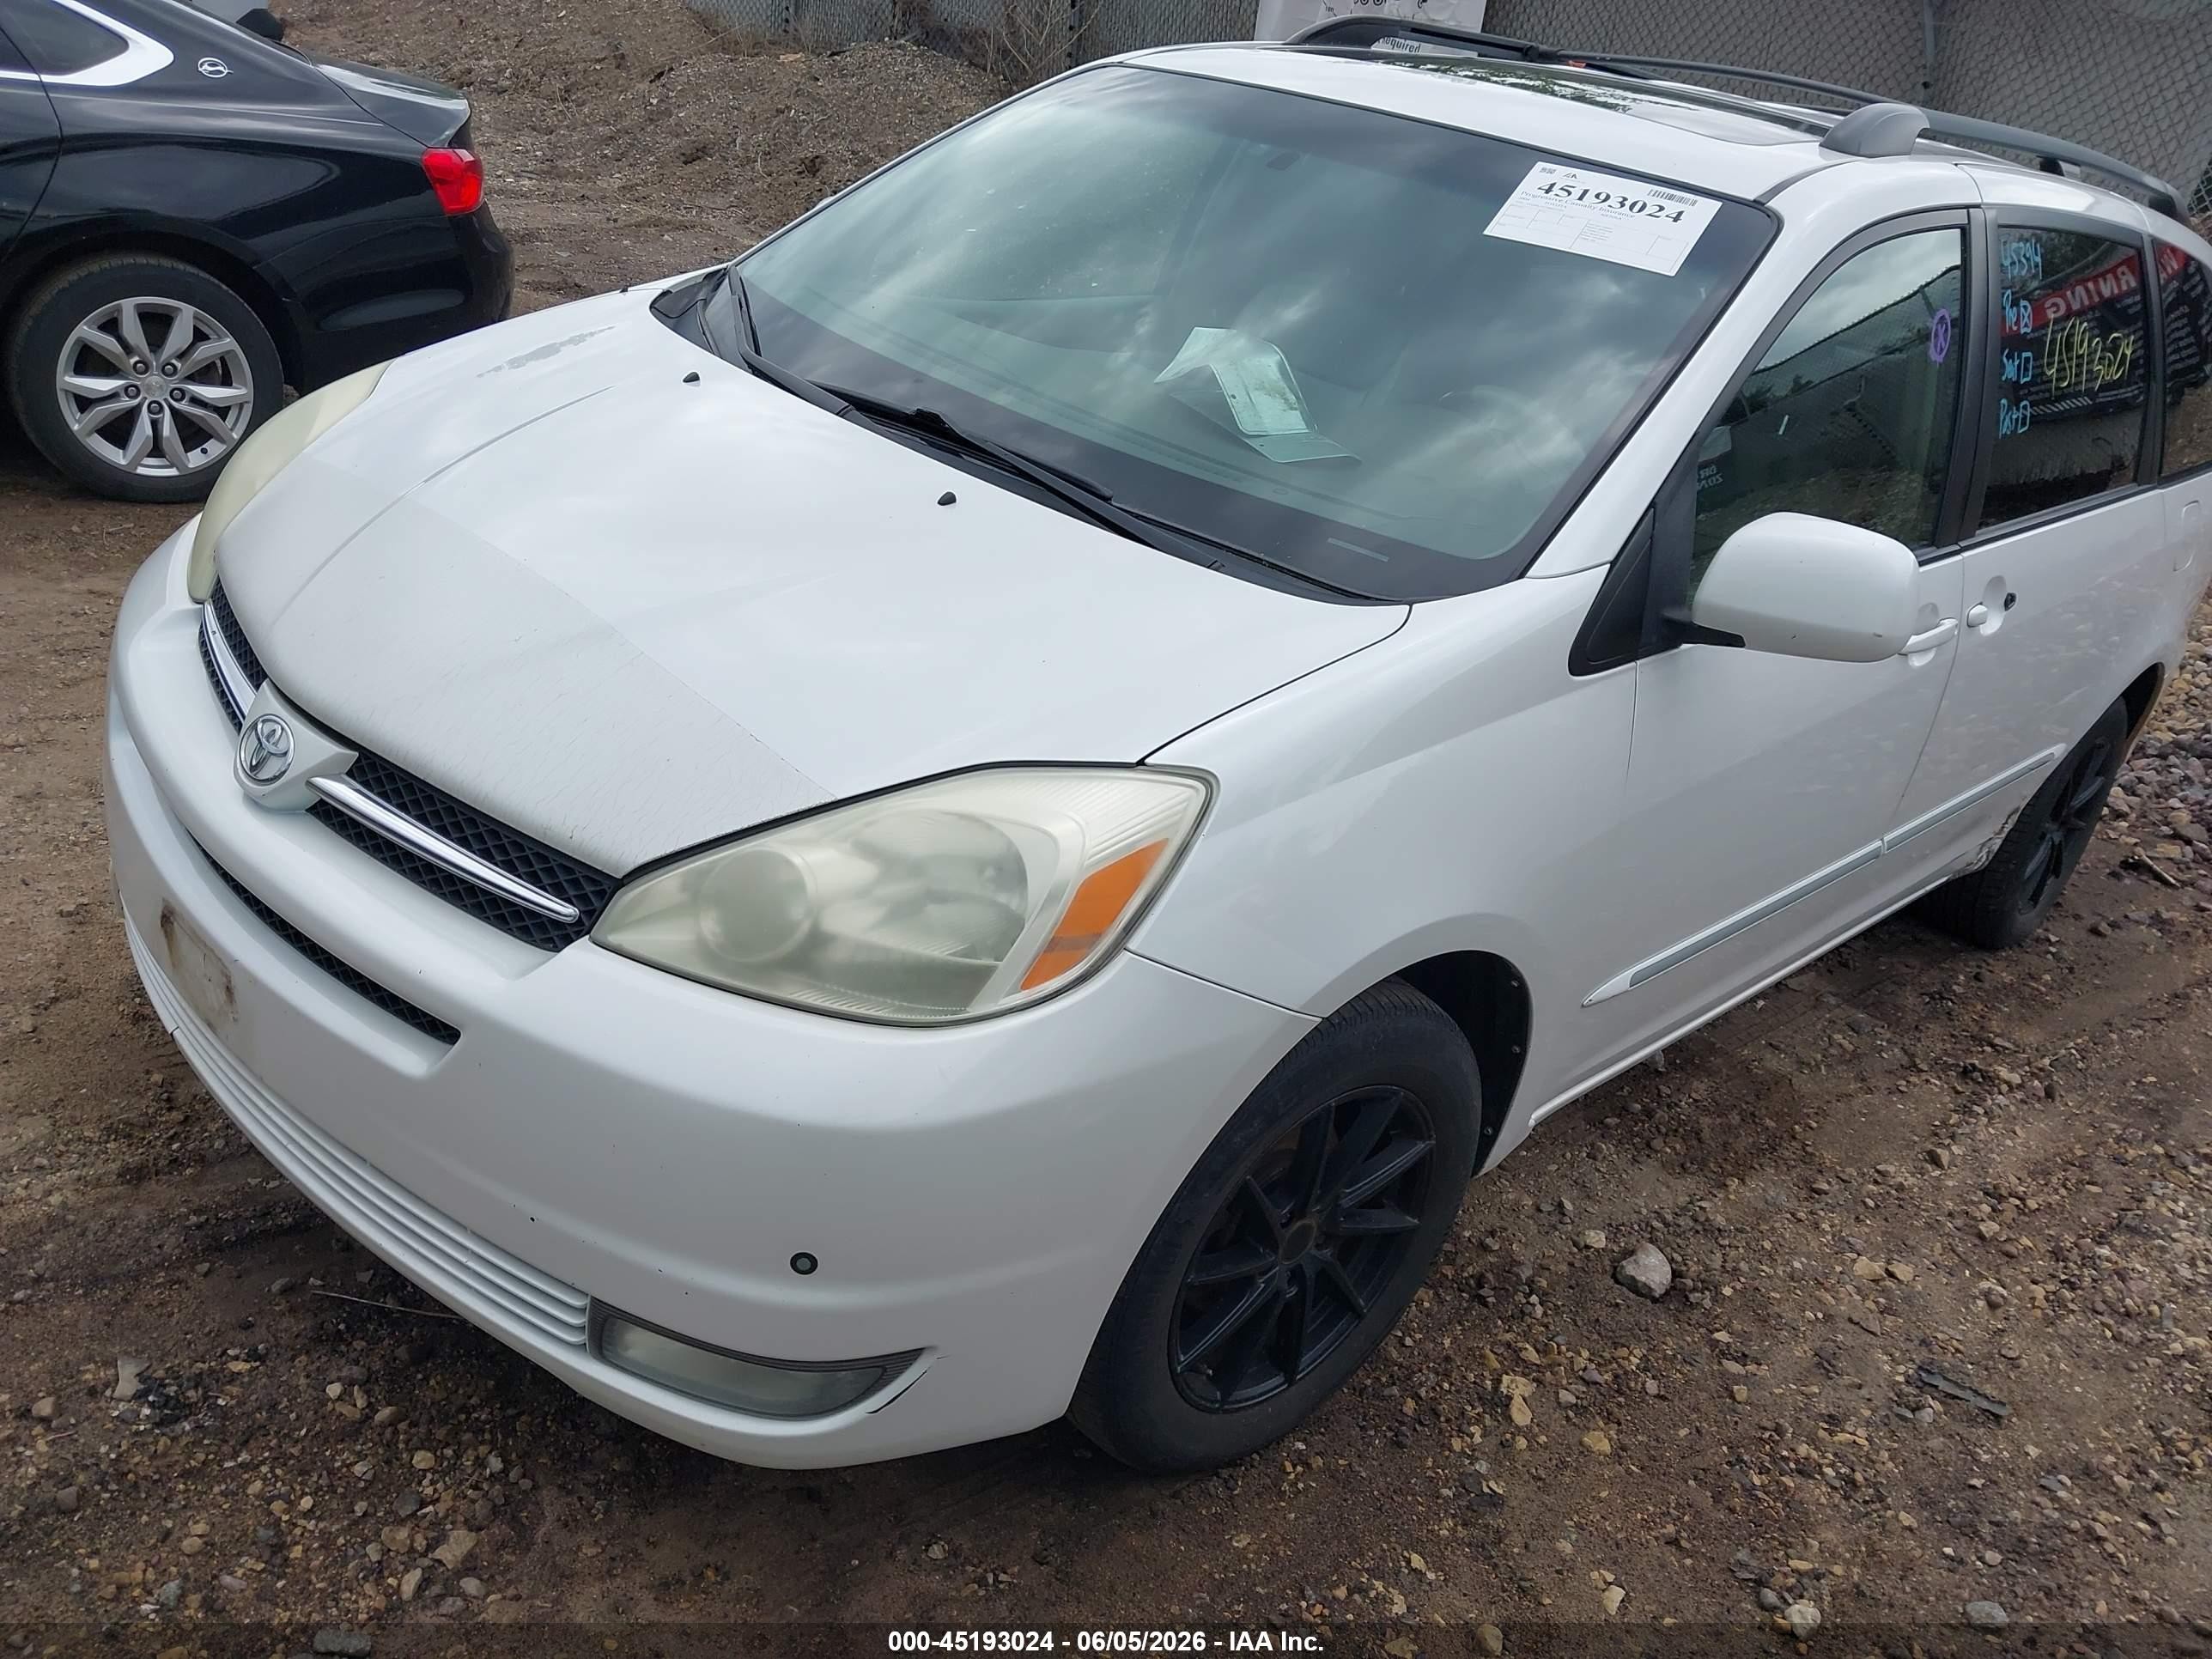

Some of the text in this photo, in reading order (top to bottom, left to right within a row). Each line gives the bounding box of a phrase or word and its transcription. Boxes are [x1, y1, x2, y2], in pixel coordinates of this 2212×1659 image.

[1377, 37, 1421, 53] equired
[1537, 180, 1686, 224] 45193024
[1599, 205, 1636, 220] Insurance
[2044, 313, 2135, 399] 45193024
